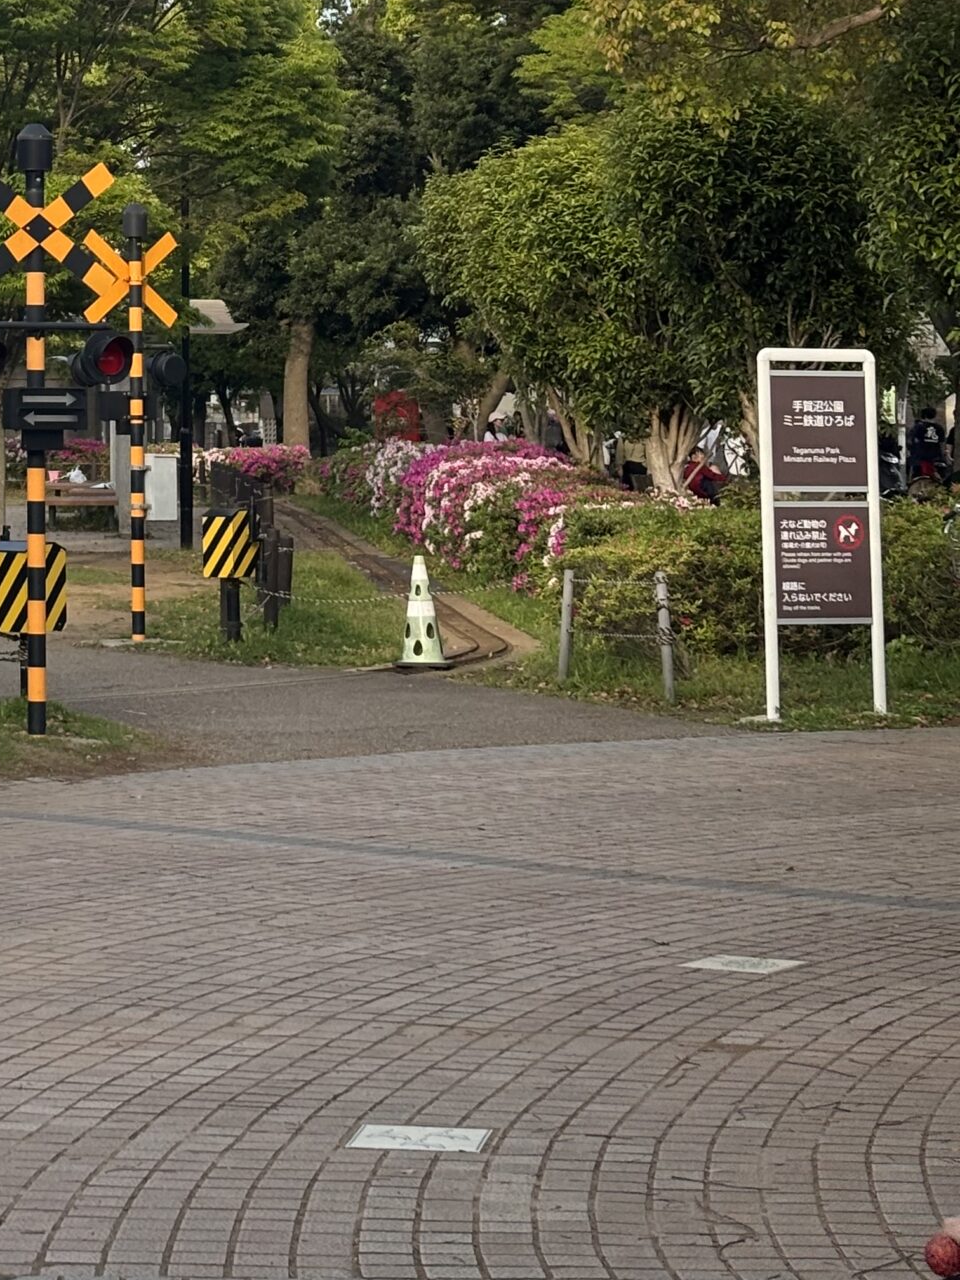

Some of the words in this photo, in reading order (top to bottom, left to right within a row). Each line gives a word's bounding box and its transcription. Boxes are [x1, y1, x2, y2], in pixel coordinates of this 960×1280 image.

[792, 400, 844, 413] 手賀沼公園
[783, 414, 855, 427] ミニ鉄道ひろば
[792, 446, 825, 455] Teganuma
[813, 455, 837, 464] Railway
[838, 455, 856, 463] Plaza
[782, 592, 852, 602] 入らないでください
